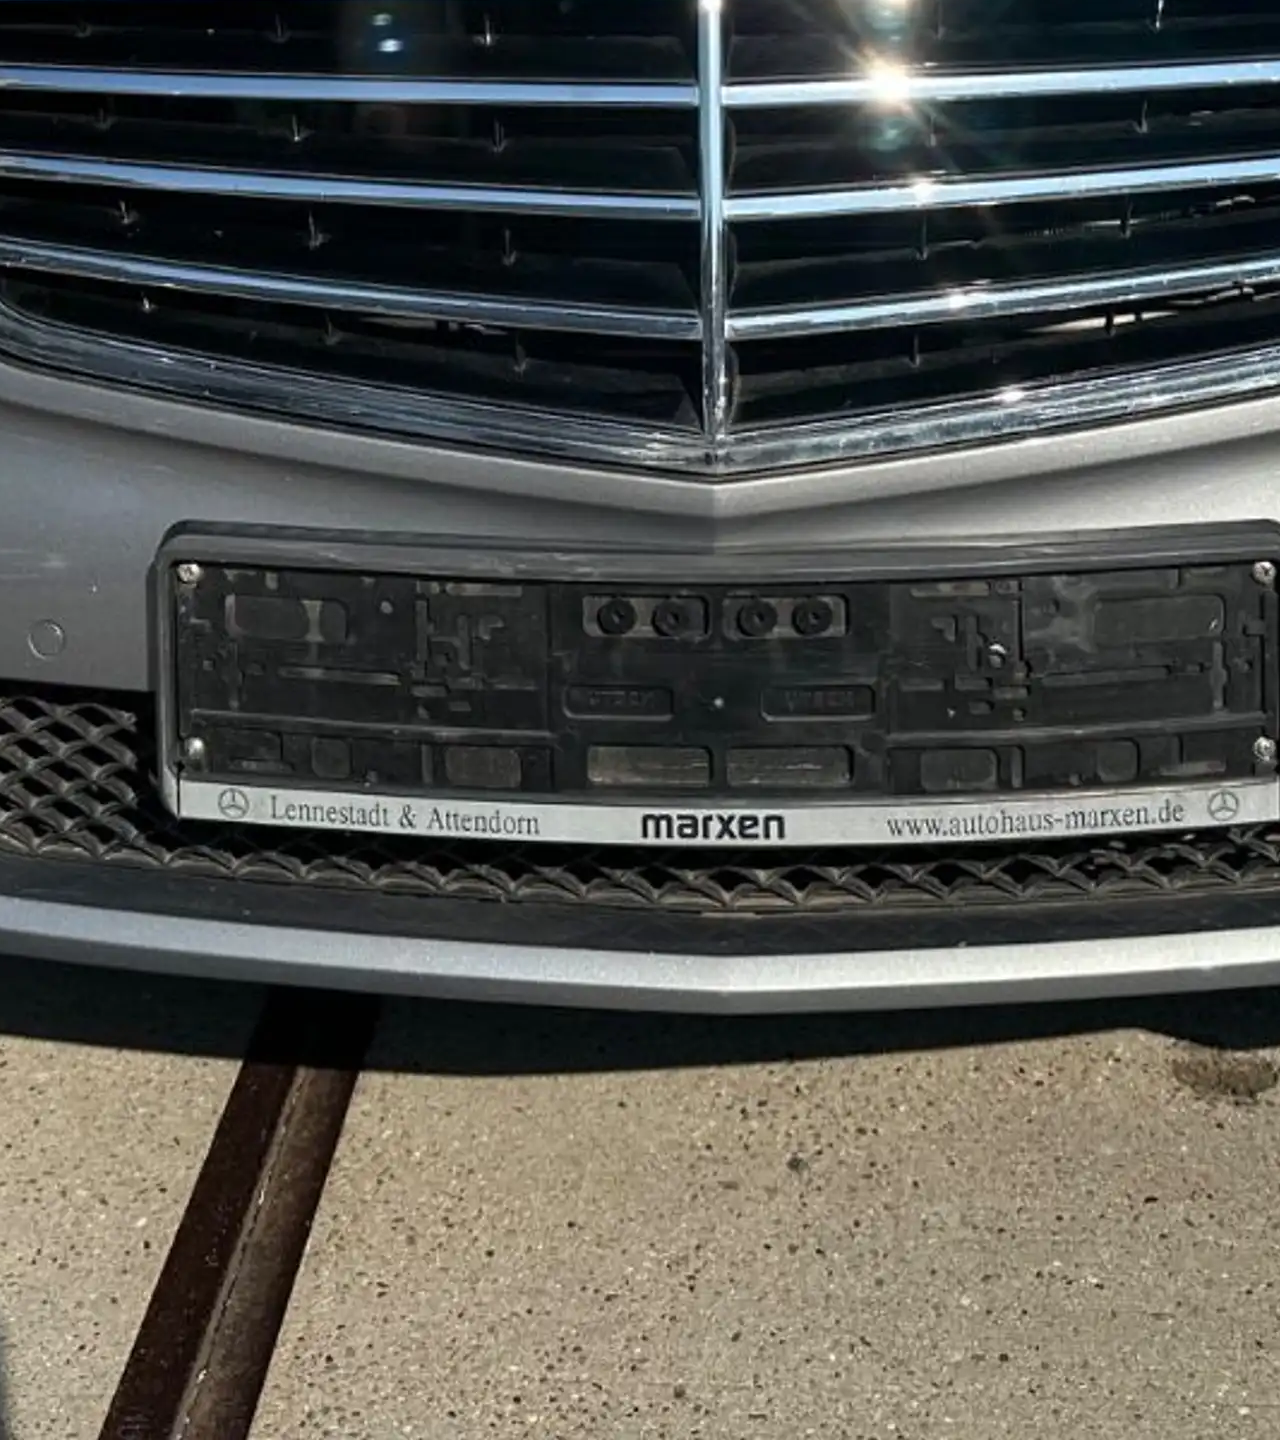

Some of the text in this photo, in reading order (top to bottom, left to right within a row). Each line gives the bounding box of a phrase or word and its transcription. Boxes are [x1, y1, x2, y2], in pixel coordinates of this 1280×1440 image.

[270, 794, 540, 835] Lennestadt & Attendorn
[641, 813, 785, 840] marxen
[886, 798, 1185, 838] www.autohaus-marxen.de
